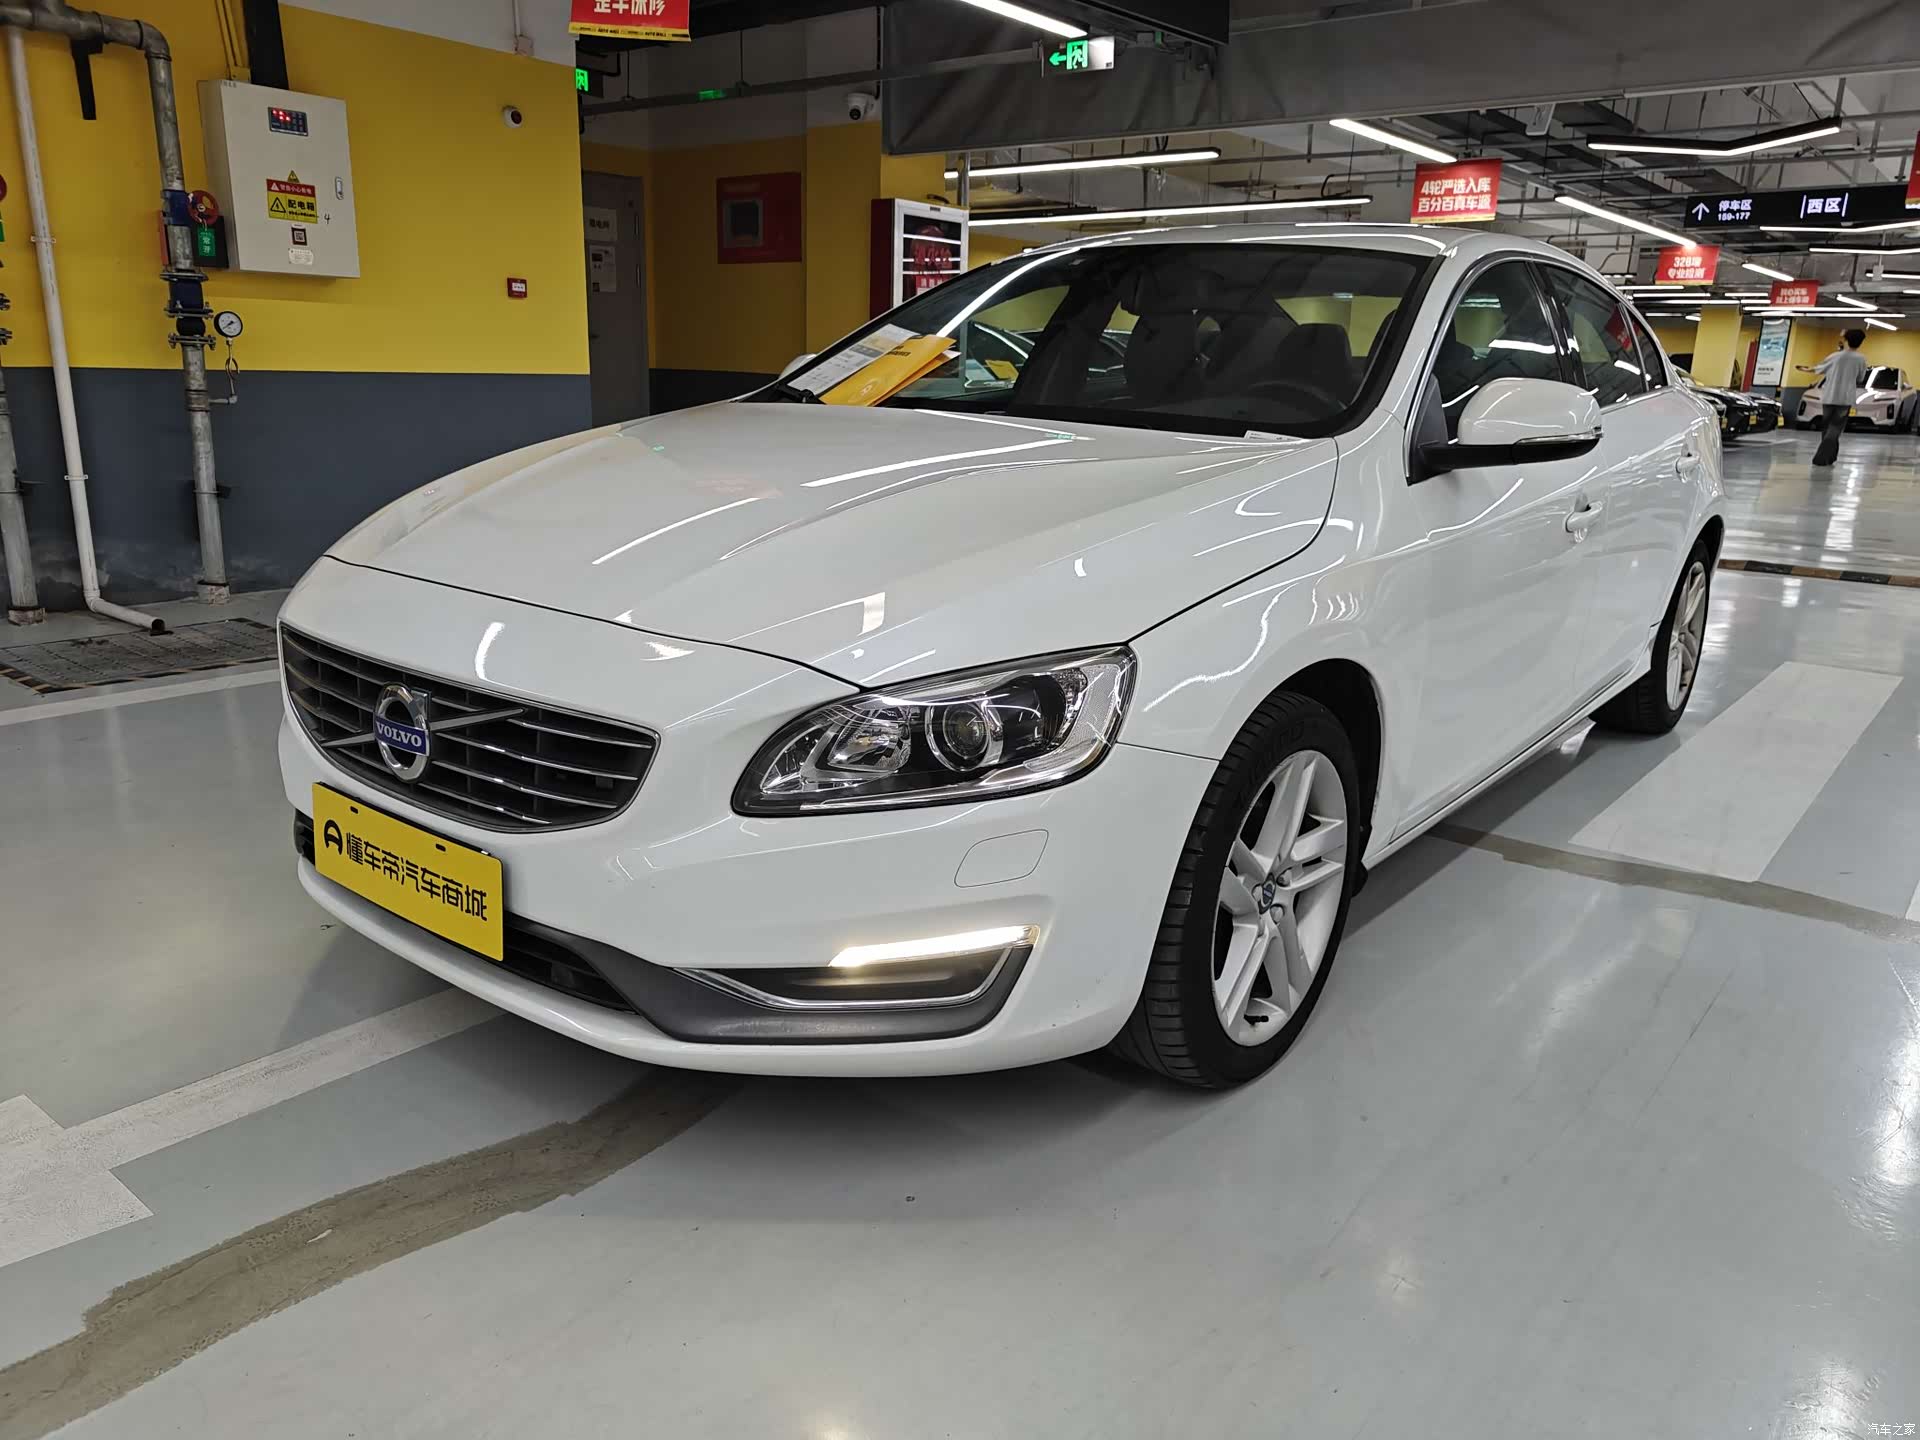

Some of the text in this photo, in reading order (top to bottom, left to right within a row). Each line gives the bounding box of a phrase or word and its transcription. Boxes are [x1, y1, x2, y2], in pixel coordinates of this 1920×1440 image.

[1421, 177, 1492, 195] 4轮严选入库
[287, 199, 315, 211] 配电箱
[1418, 194, 1492, 213] 百分百真车源
[1719, 199, 1752, 212] 停车区
[1807, 197, 1842, 214] 西区
[376, 721, 422, 747] VOLVO
[346, 831, 488, 922] 懂车帝汽车商城
